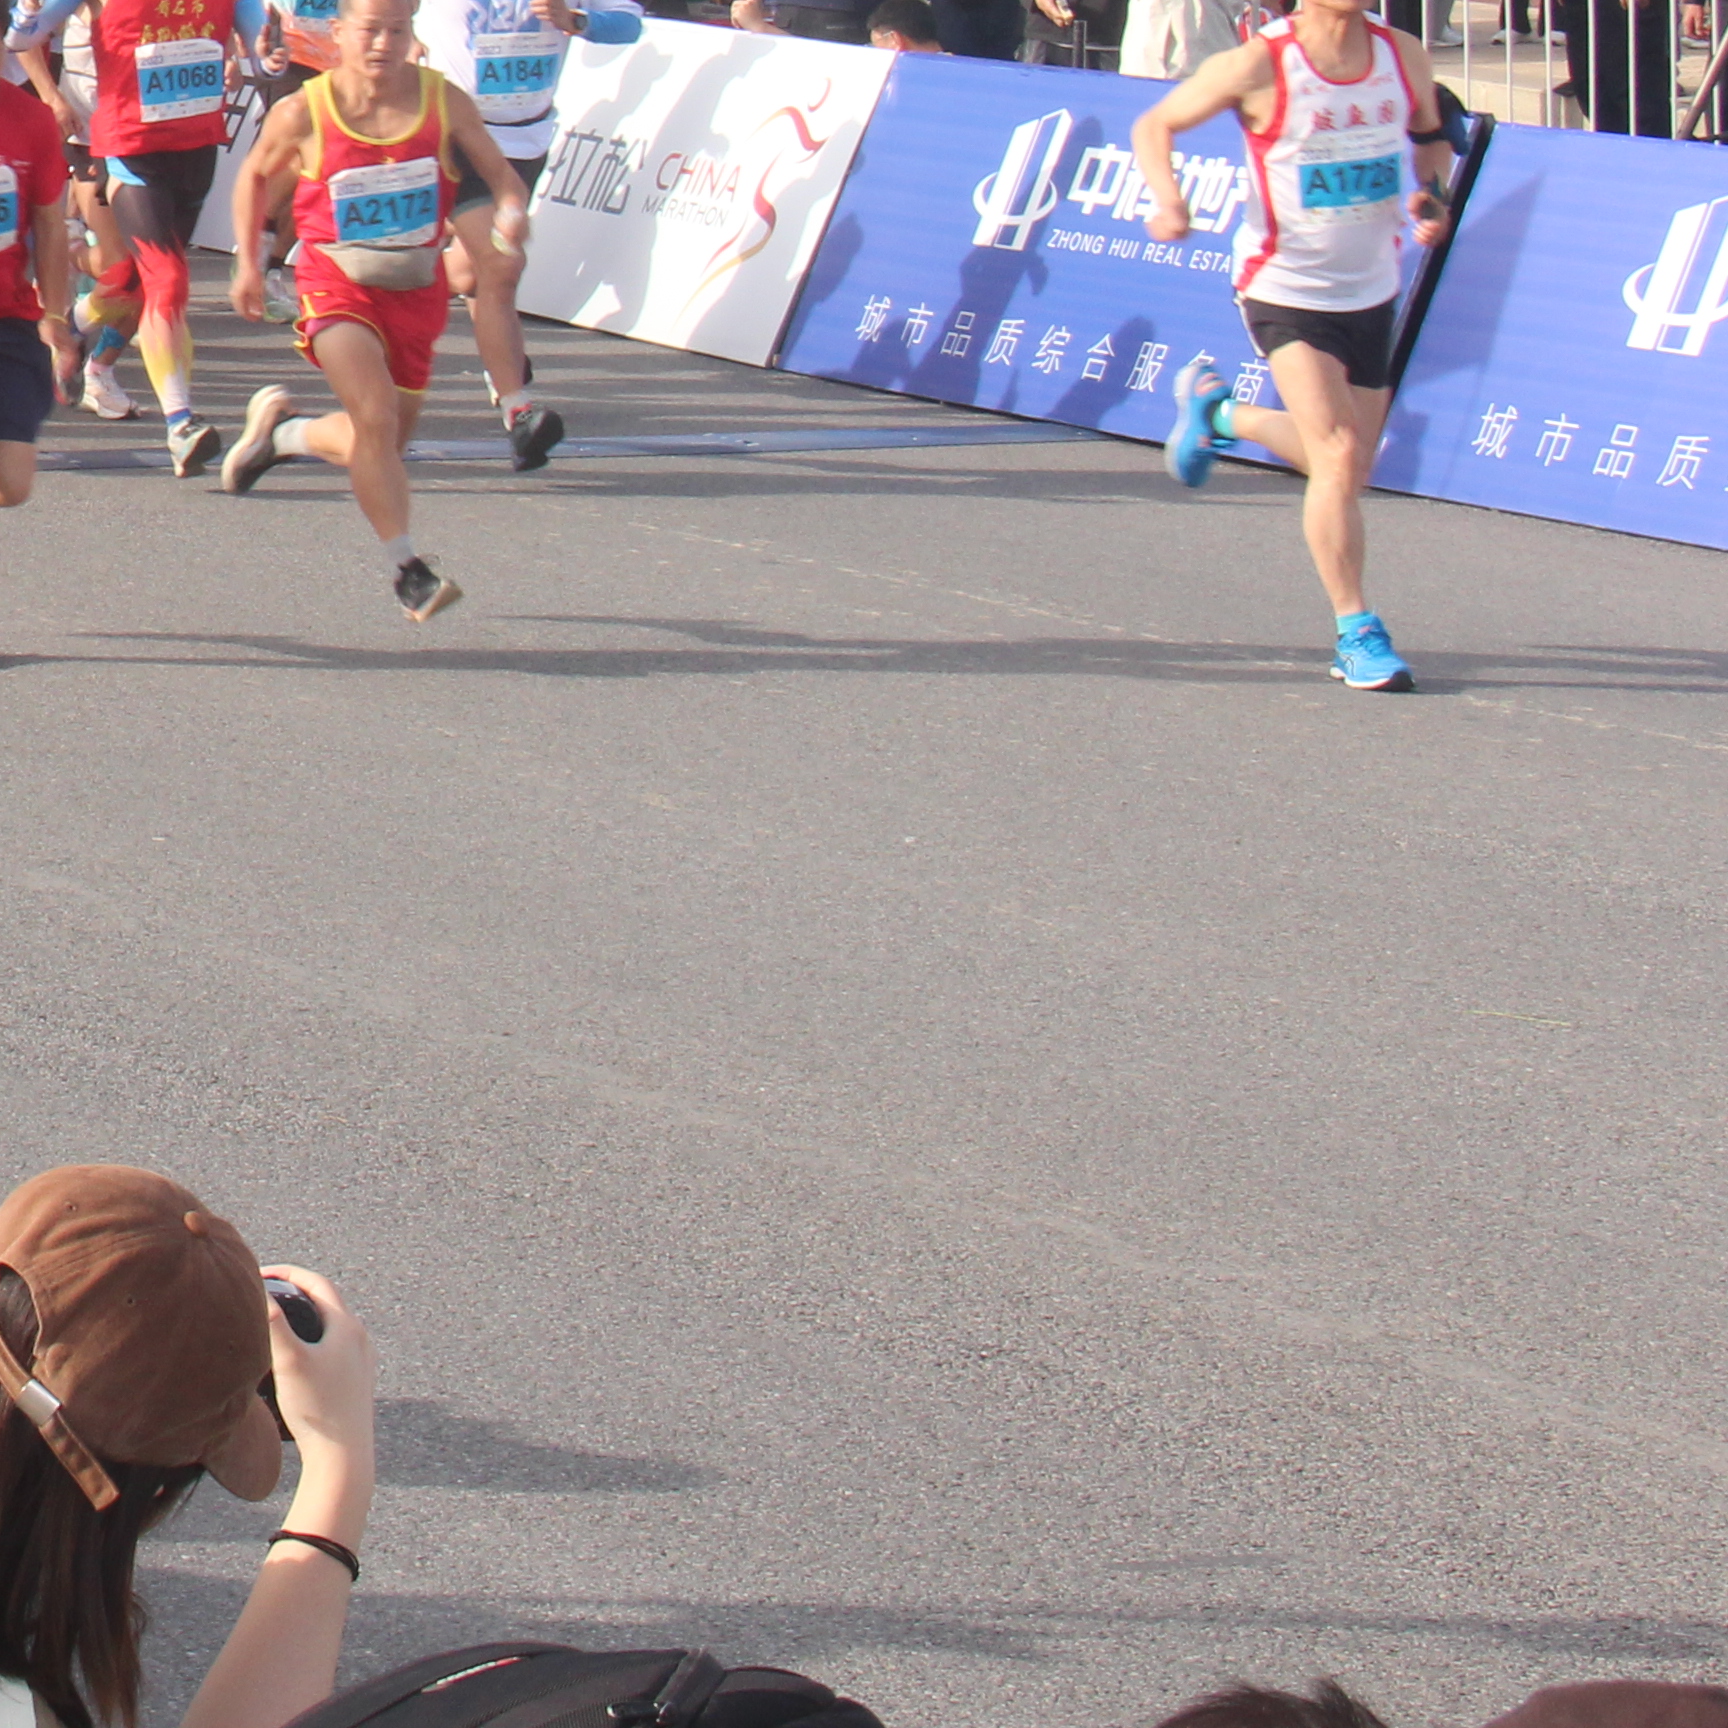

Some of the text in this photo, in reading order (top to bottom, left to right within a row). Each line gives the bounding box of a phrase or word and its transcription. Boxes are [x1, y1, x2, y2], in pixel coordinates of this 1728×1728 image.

[145, 64, 218, 94] A1068
[539, 124, 647, 215] 拉松
[654, 151, 741, 198] CHINA
[344, 191, 433, 228] A2172
[641, 195, 731, 228] MARATHON
[1047, 226, 1104, 257] ZHONG
[1107, 236, 1141, 261] HUI
[1144, 242, 1185, 269] REAL
